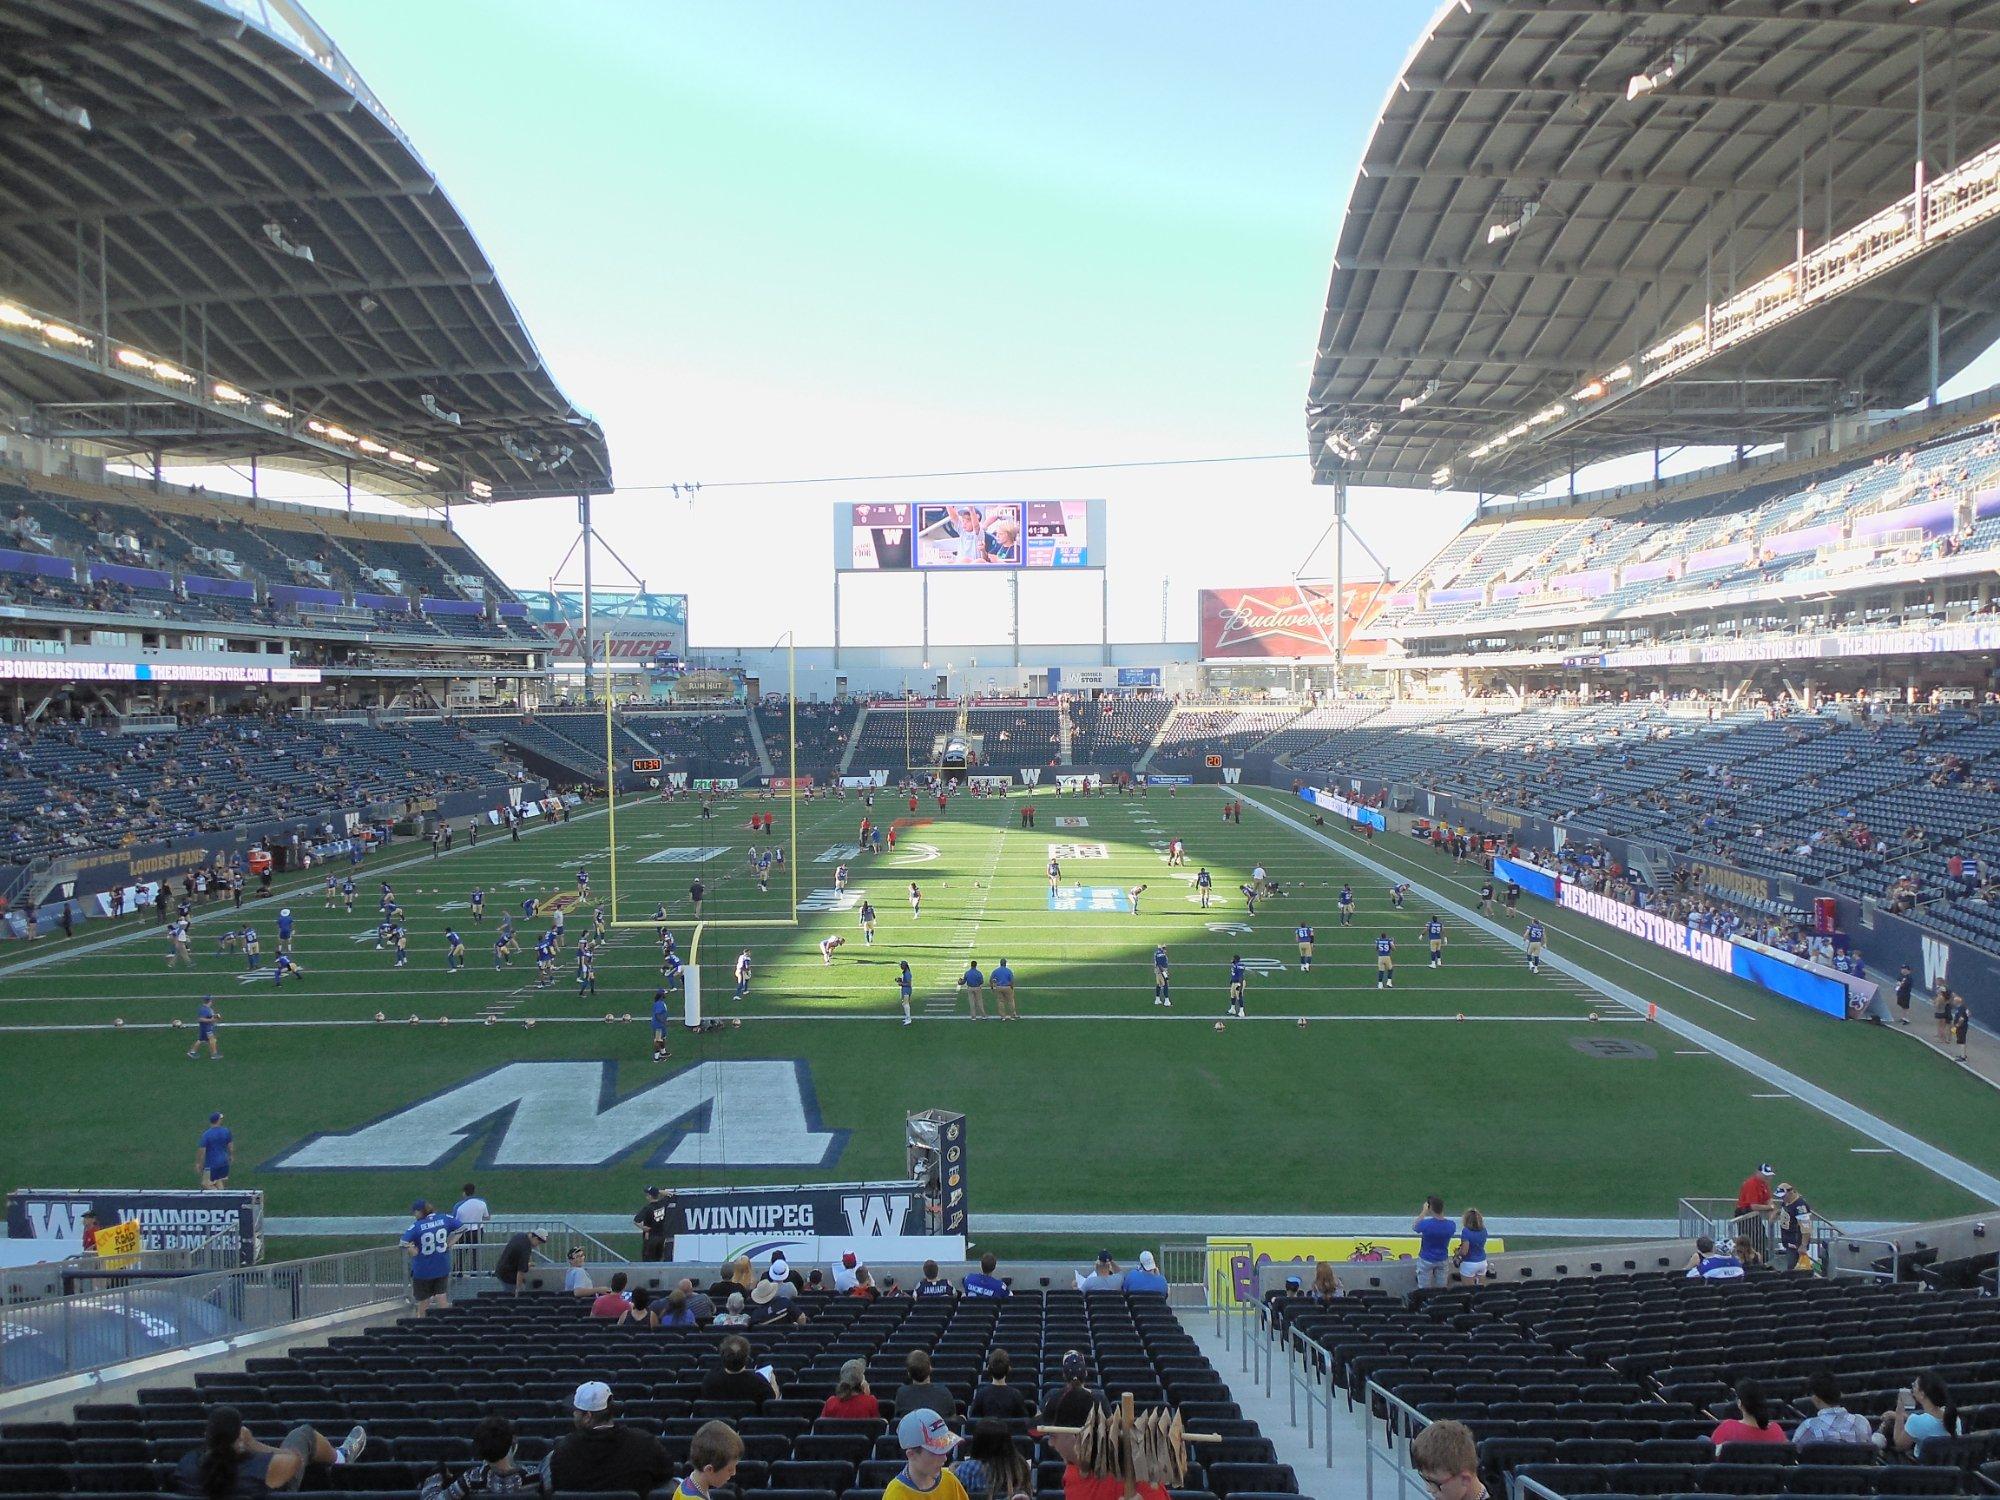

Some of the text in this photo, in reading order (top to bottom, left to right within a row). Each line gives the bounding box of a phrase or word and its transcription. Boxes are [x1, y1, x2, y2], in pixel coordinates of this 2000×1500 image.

[150, 664, 268, 682] THEBOMBERSTORE.COM
[635, 760, 660, 769] 41:39
[1207, 757, 1221, 766] 20
[1222, 768, 1241, 783] W
[130, 848, 205, 876] LOUDEST FANS
[1560, 882, 1733, 974] THEBOMBERSTORE.COM
[1921, 934, 1950, 990] W
[26, 1201, 92, 1240] W
[118, 1208, 239, 1232] WINNIPEG
[420, 1219, 445, 1231] DENMARK
[685, 1204, 814, 1230] WINNIPEG
[840, 1194, 913, 1236] W
[421, 1228, 448, 1255] 89
[923, 1285, 947, 1295] JANUARY
